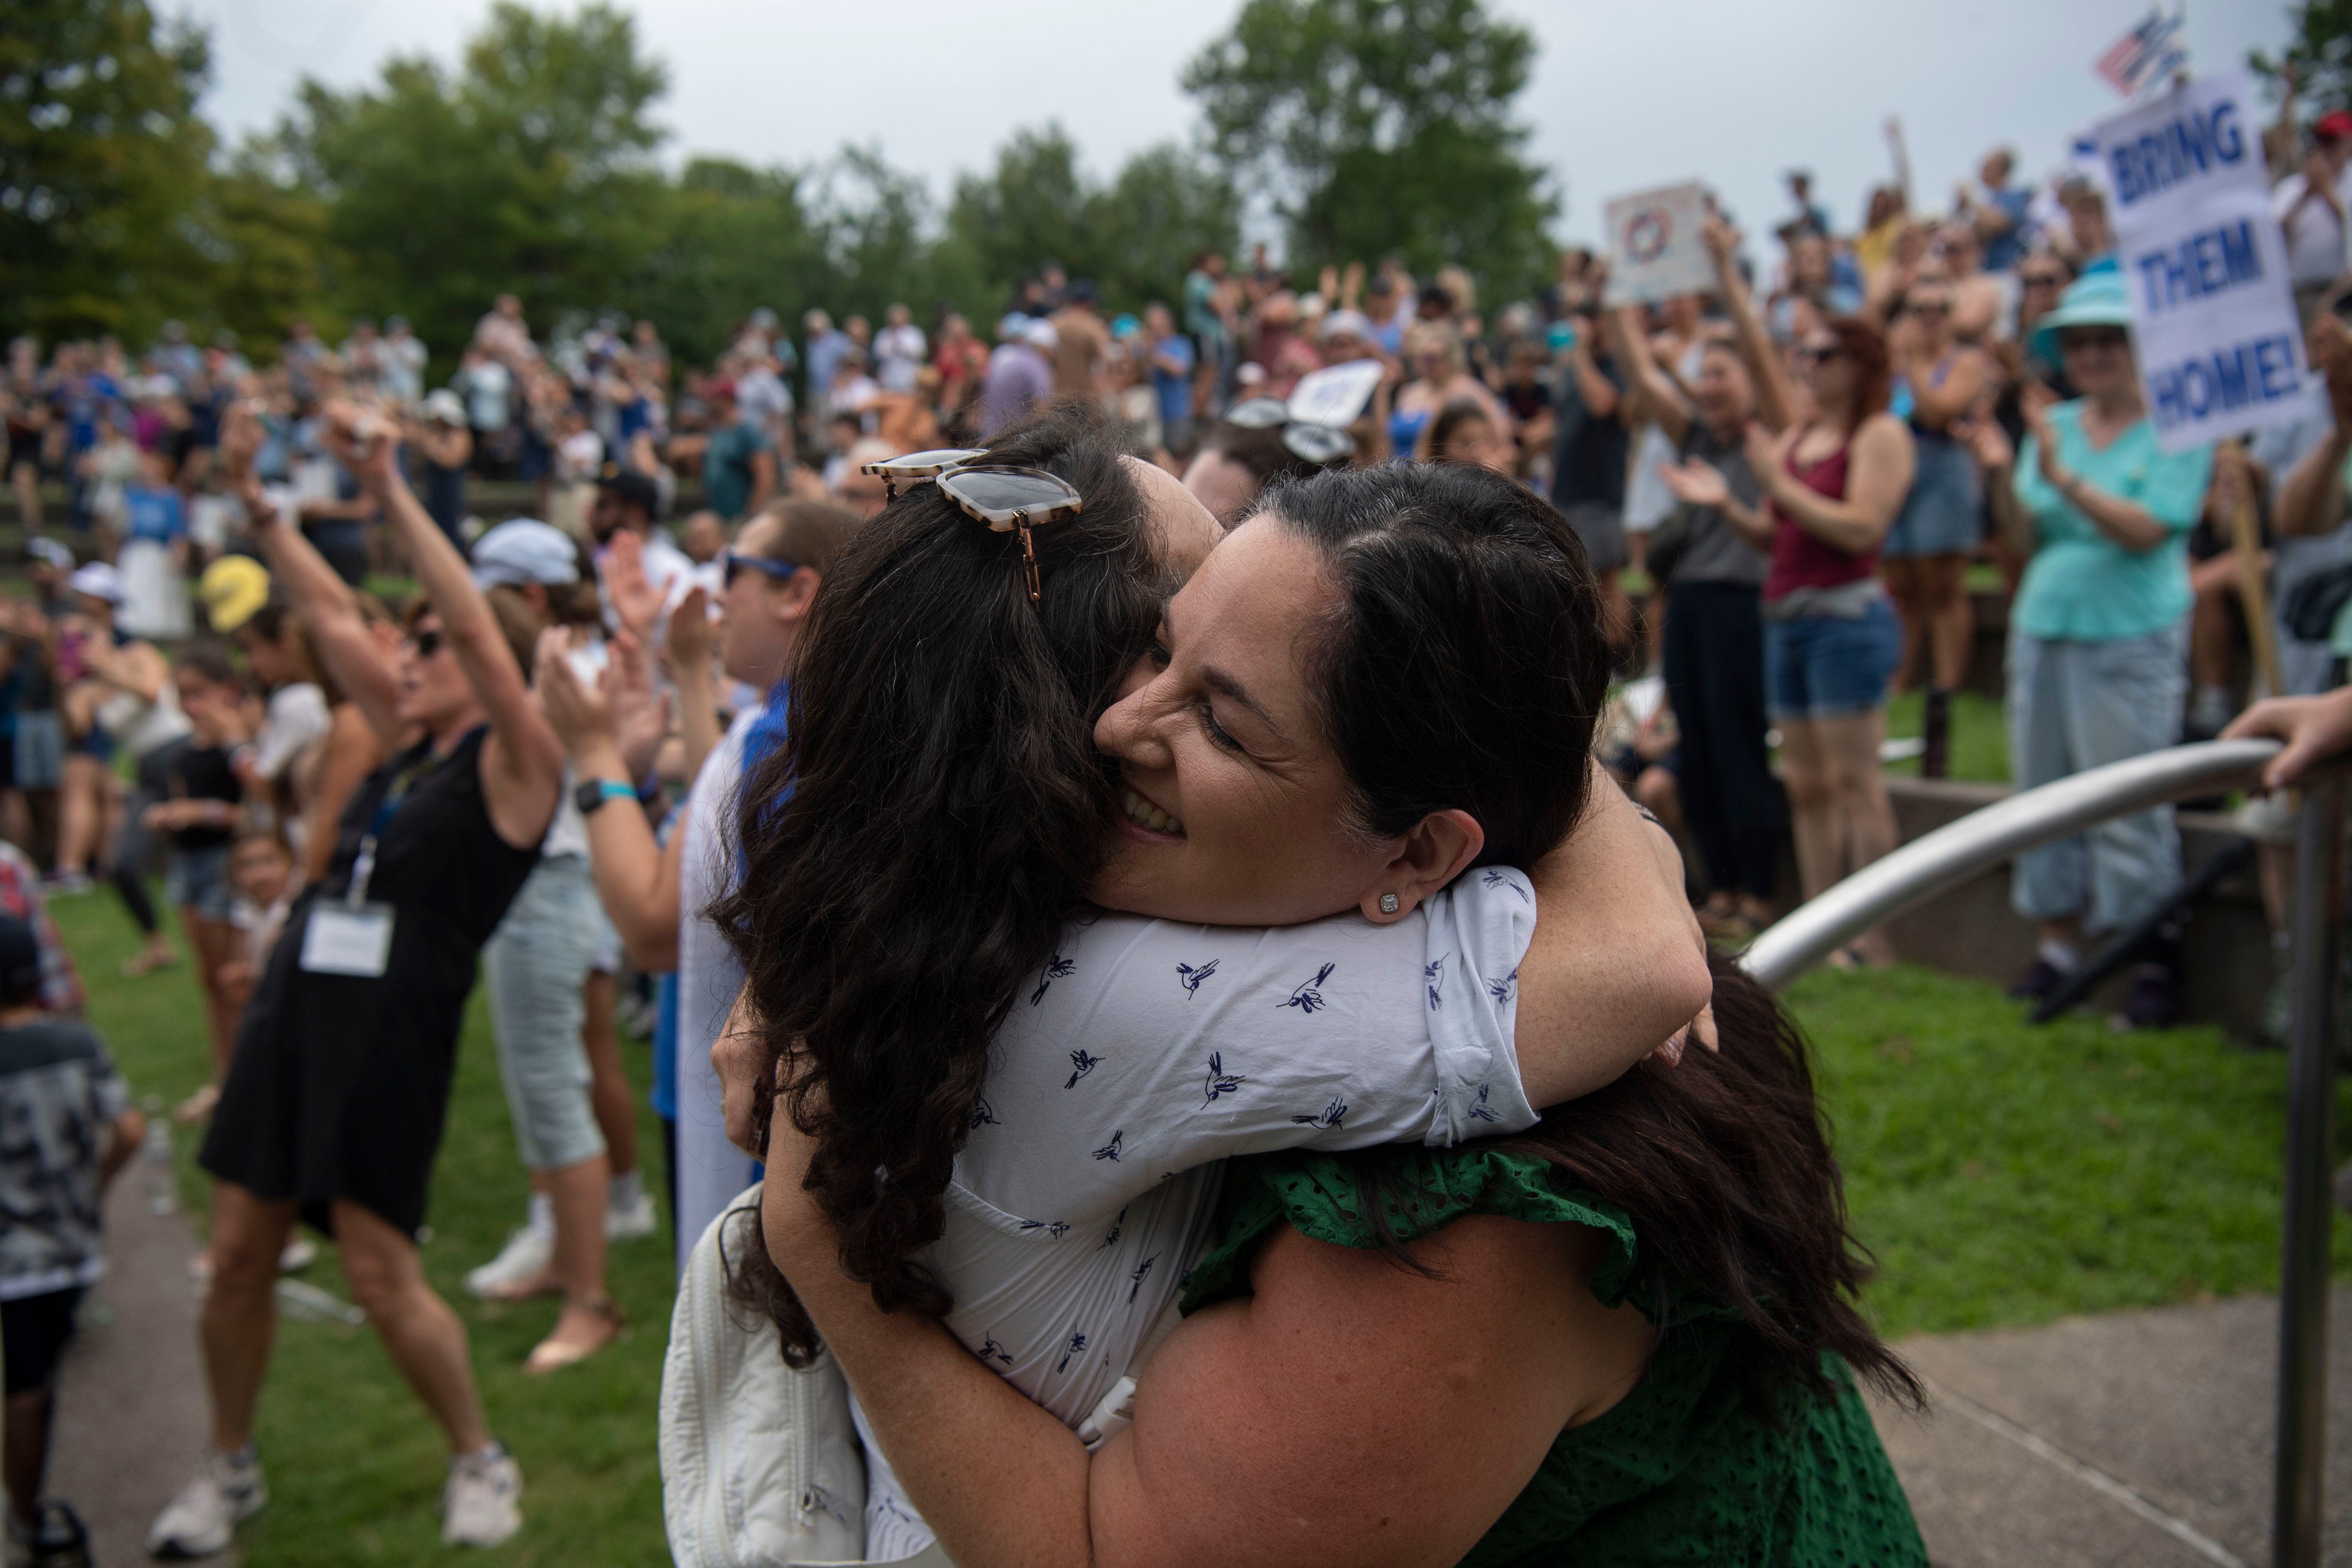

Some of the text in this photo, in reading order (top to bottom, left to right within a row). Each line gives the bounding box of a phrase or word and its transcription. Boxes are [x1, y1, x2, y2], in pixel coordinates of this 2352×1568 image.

[2113, 102, 2242, 204] BRING
[2139, 218, 2261, 313] THEM
[2153, 337, 2299, 425] HOME!
